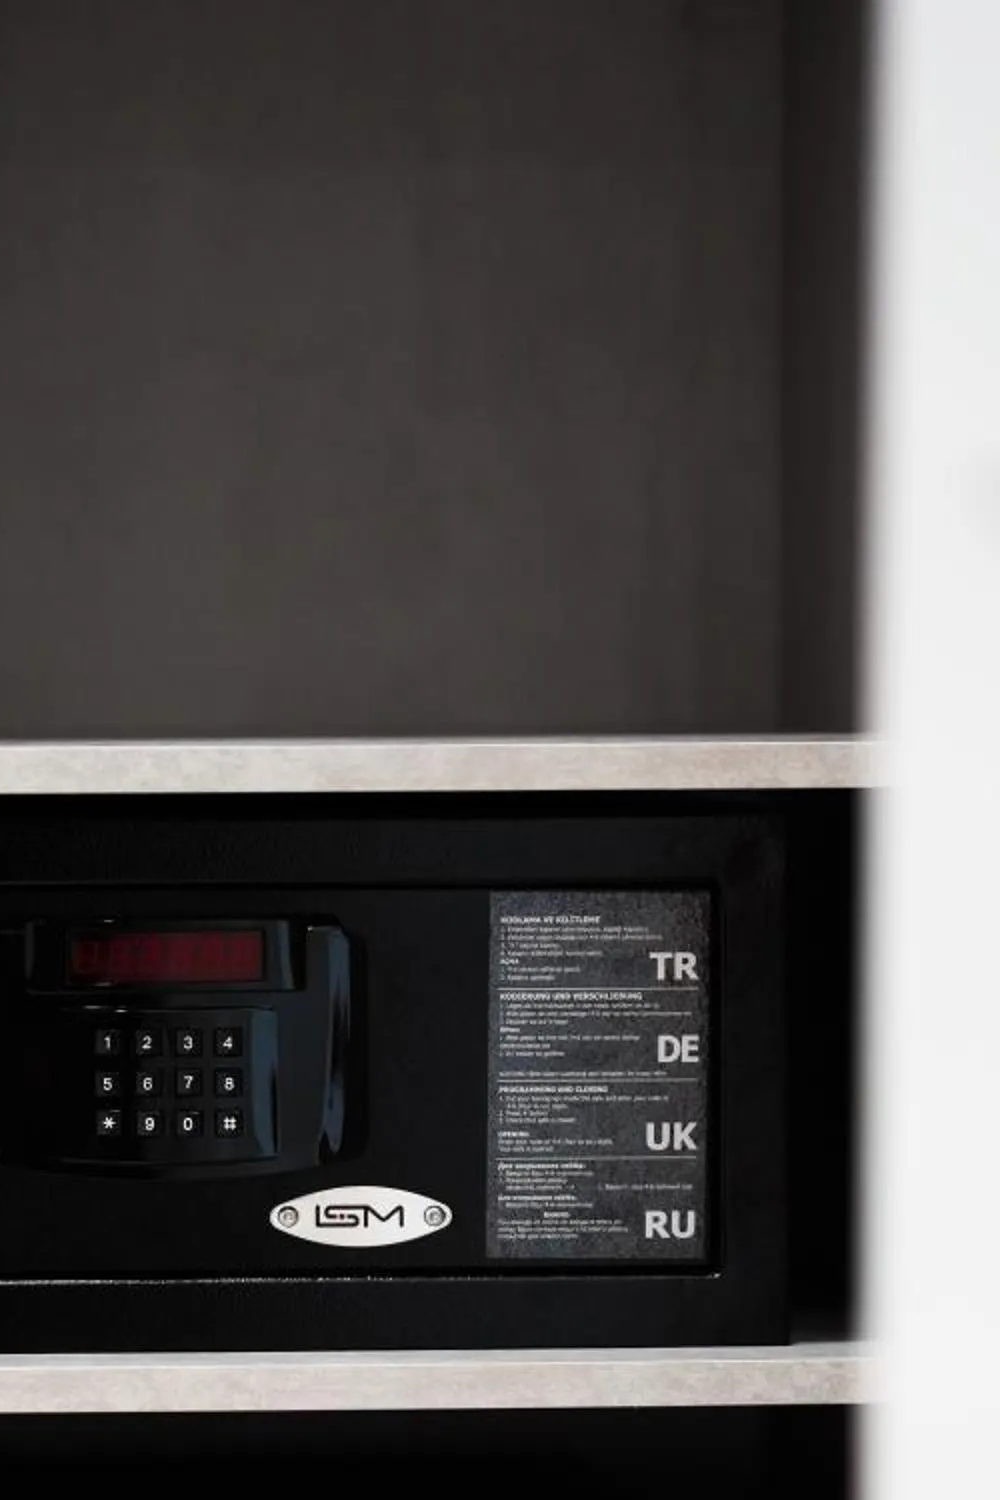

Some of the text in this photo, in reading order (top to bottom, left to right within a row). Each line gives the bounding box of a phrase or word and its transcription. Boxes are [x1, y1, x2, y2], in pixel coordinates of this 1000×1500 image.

[649, 951, 698, 981] TR
[103, 1035, 233, 1050] 1 2 3 4
[657, 1035, 699, 1063] DE
[103, 1075, 235, 1091] 5 6 7 8
[144, 1117, 155, 1131] 9
[182, 1117, 194, 1131] 0
[645, 1122, 697, 1151] UK
[645, 1210, 695, 1239] RU
